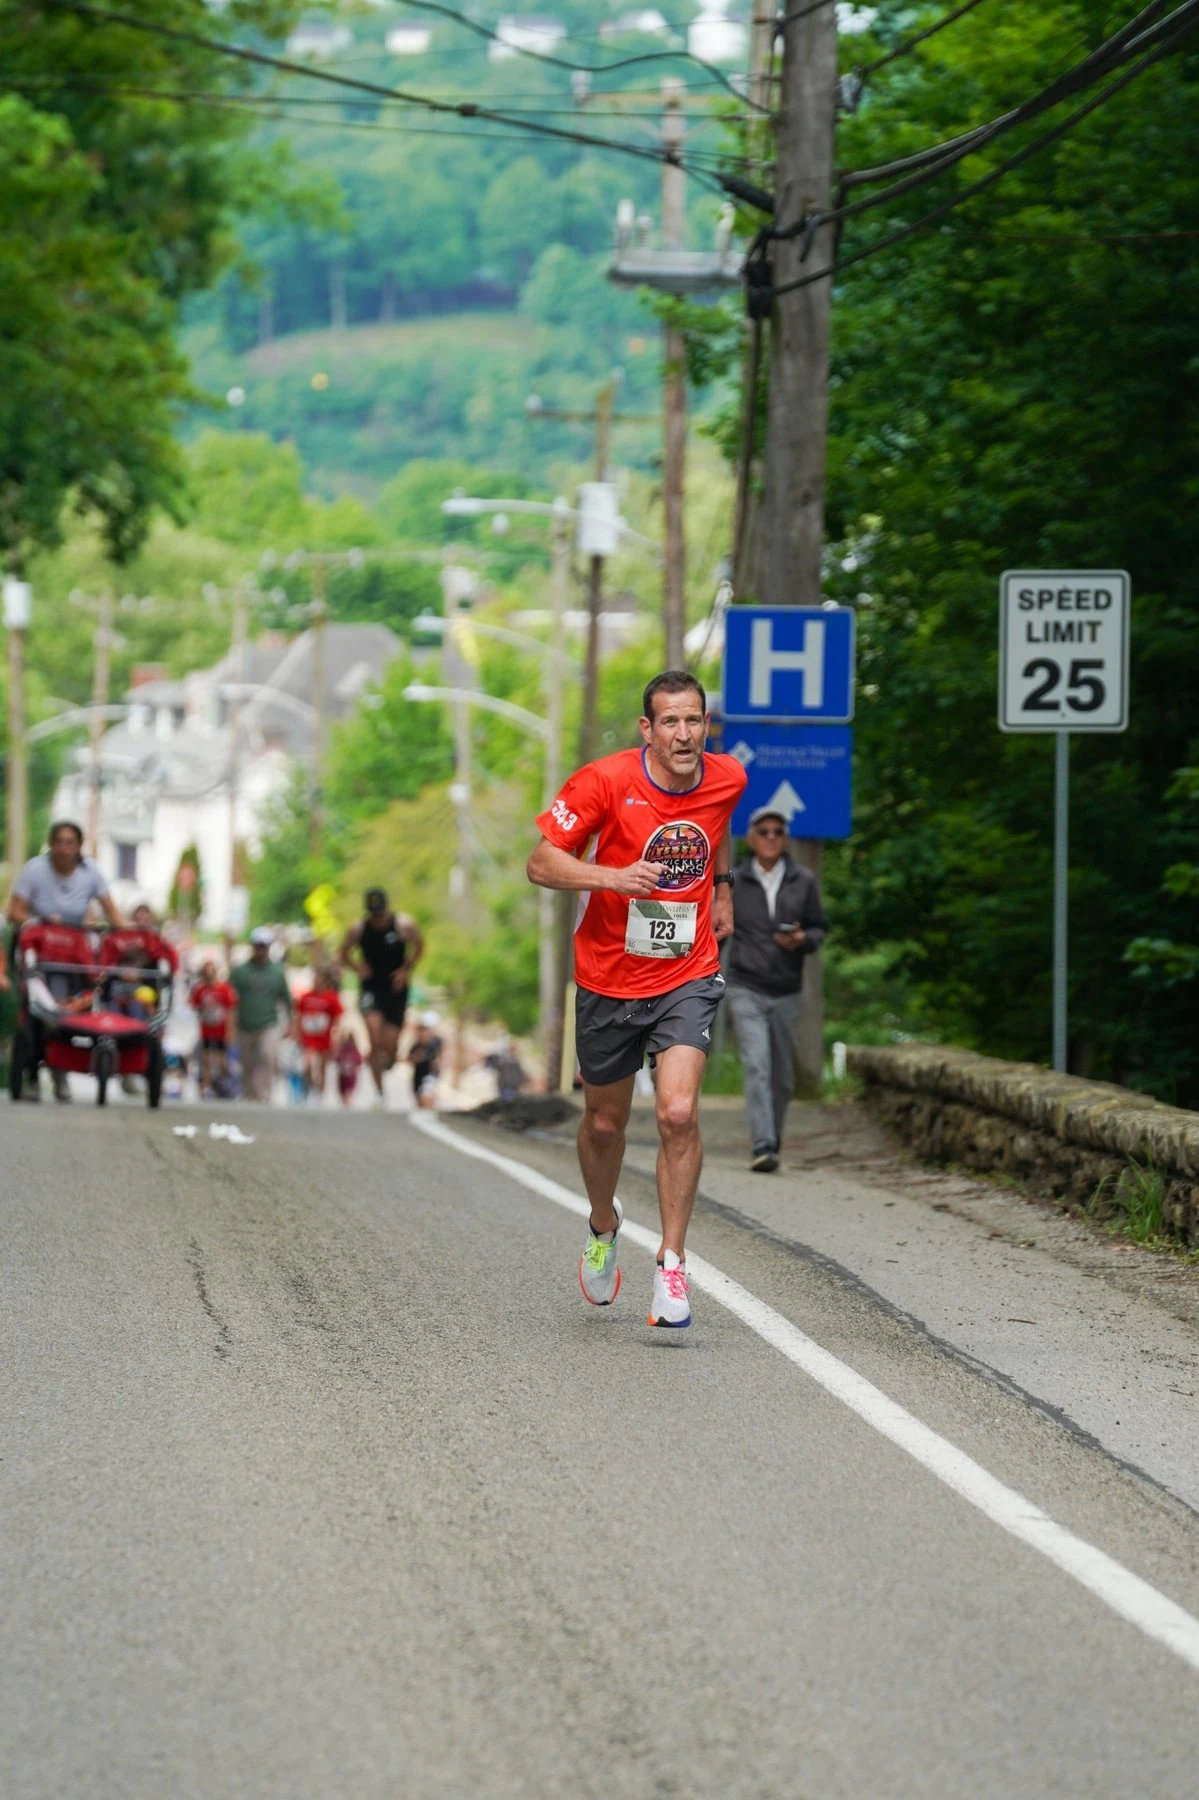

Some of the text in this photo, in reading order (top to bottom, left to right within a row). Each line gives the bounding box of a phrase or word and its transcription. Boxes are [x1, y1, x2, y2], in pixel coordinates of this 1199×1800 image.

[1018, 589, 1112, 610] SPEED
[1026, 621, 1102, 643] LIMIT
[750, 618, 825, 708] H
[1021, 657, 1107, 712] 25
[668, 864, 703, 875] NNERS
[649, 920, 676, 940] 123
